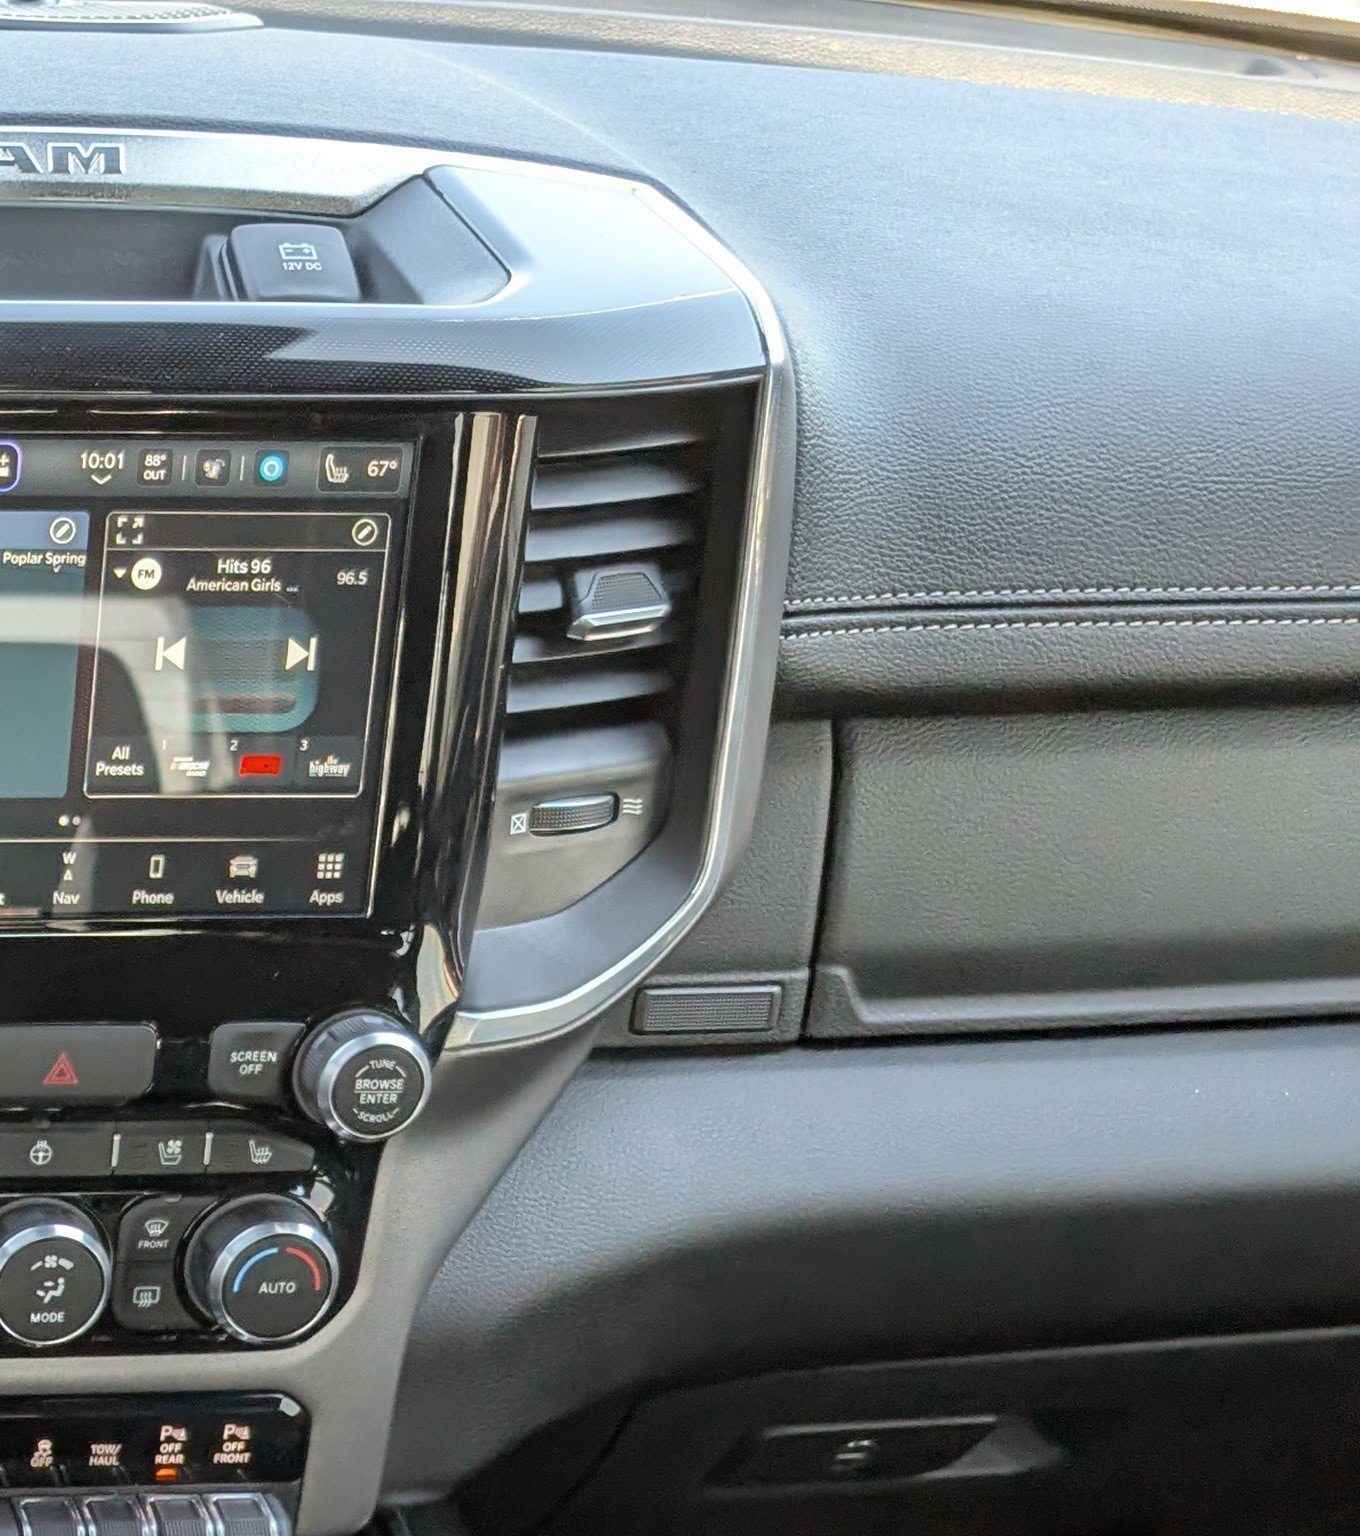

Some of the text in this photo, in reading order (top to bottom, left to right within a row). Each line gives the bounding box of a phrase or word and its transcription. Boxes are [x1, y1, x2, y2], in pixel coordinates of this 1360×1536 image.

[282, 261, 322, 271] 12V DC
[80, 453, 125, 470] 10:01
[144, 453, 166, 467] 88°
[143, 470, 166, 481] OUT
[367, 461, 398, 478] 67°
[2, 551, 87, 568] Poplar Spring
[217, 558, 272, 574] Hits 96
[137, 568, 156, 579] FM
[336, 570, 369, 586] 96.5
[185, 577, 281, 593] American Girls
[230, 739, 238, 751] 2
[299, 740, 308, 751] 3
[111, 745, 130, 760] All
[95, 762, 144, 777] Presets
[308, 760, 351, 777] highway
[52, 891, 80, 905] Nav
[132, 891, 175, 905] Phone
[216, 890, 265, 904] Vehicle
[309, 890, 345, 906] Apps
[230, 1051, 277, 1064] SCREEN
[239, 1064, 264, 1075] OFF
[369, 1059, 397, 1071] TUNE
[355, 1078, 405, 1090] BROWSE
[359, 1093, 398, 1104] ENTER
[357, 1111, 395, 1123] SCROLL
[138, 1240, 169, 1249] FRONT
[258, 1281, 296, 1295] AUTO
[30, 1312, 65, 1323] MODE
[90, 1443, 122, 1455] TOW/
[160, 1443, 182, 1454] OFF
[222, 1441, 246, 1452] OFF
[30, 1456, 52, 1468] OFF
[89, 1455, 120, 1467] HAUL
[155, 1454, 184, 1465] REAR
[213, 1452, 251, 1464] FRONT
